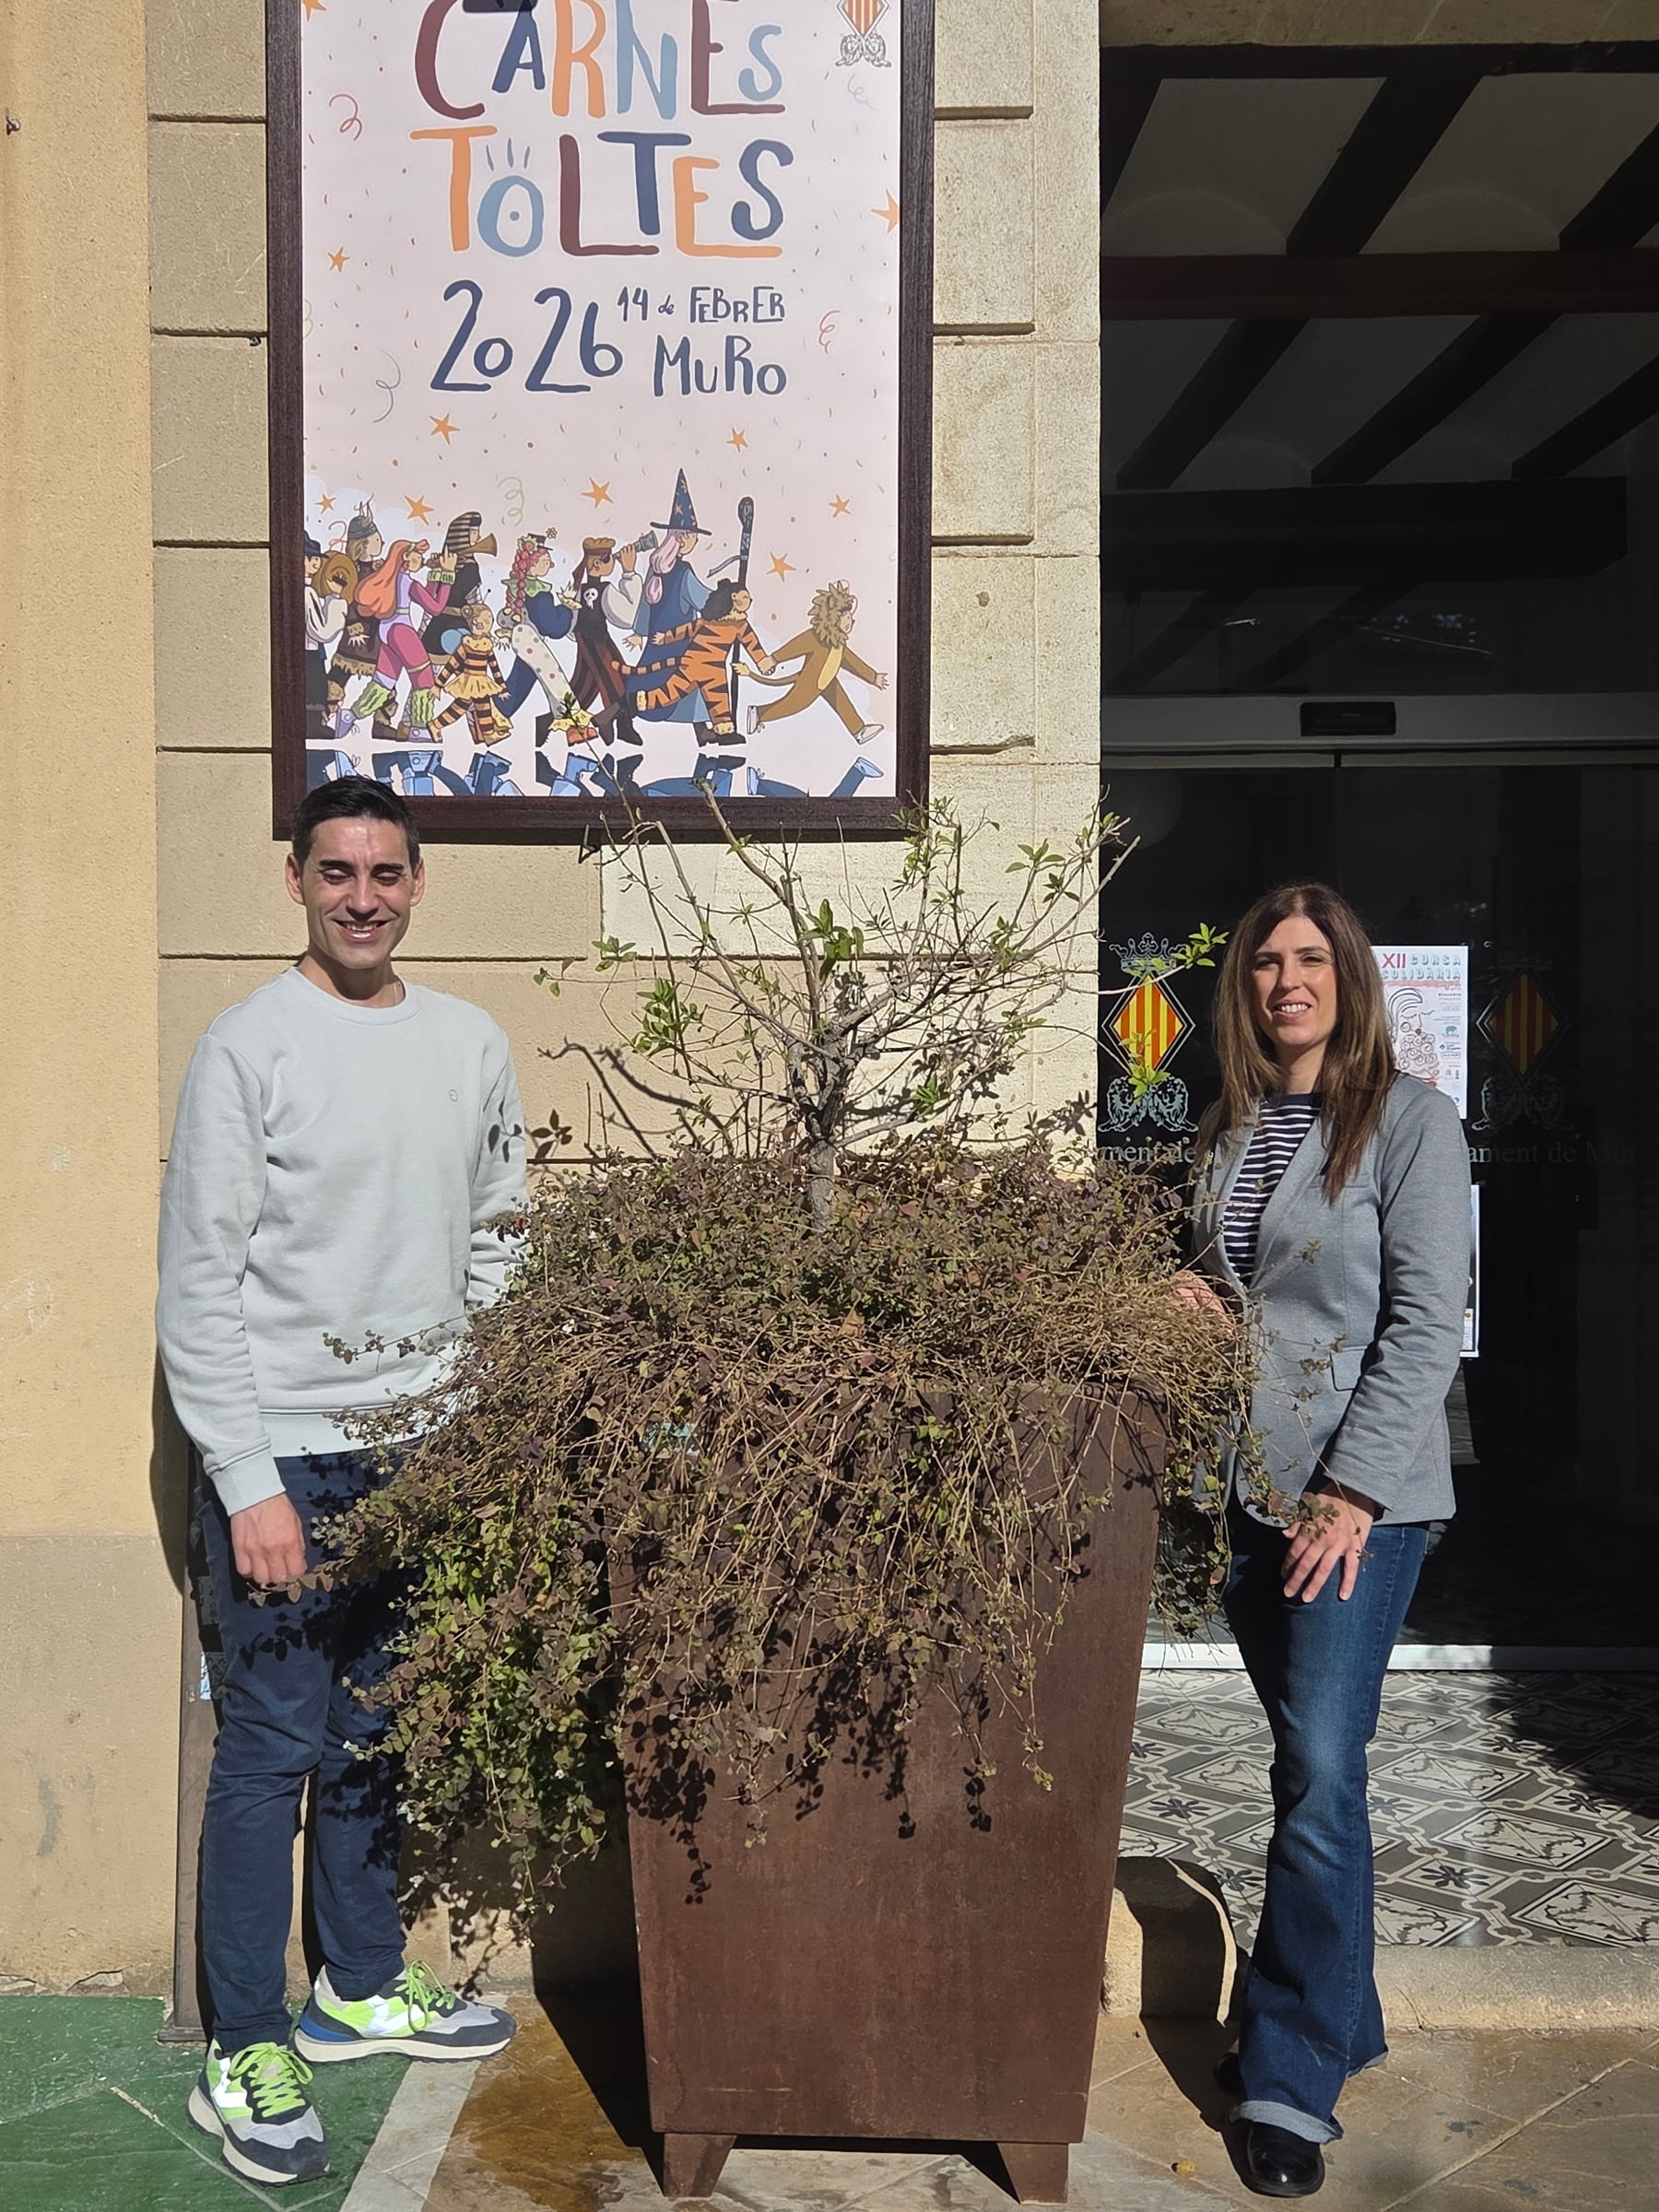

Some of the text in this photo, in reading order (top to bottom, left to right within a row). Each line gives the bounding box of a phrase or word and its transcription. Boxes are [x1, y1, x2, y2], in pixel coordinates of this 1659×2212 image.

[415, 0, 785, 119] CARNES
[410, 125, 794, 257] TOLTES
[430, 279, 622, 392] 2026
[618, 286, 784, 323] 14 de FEBRER
[1382, 953, 1406, 968] XII
